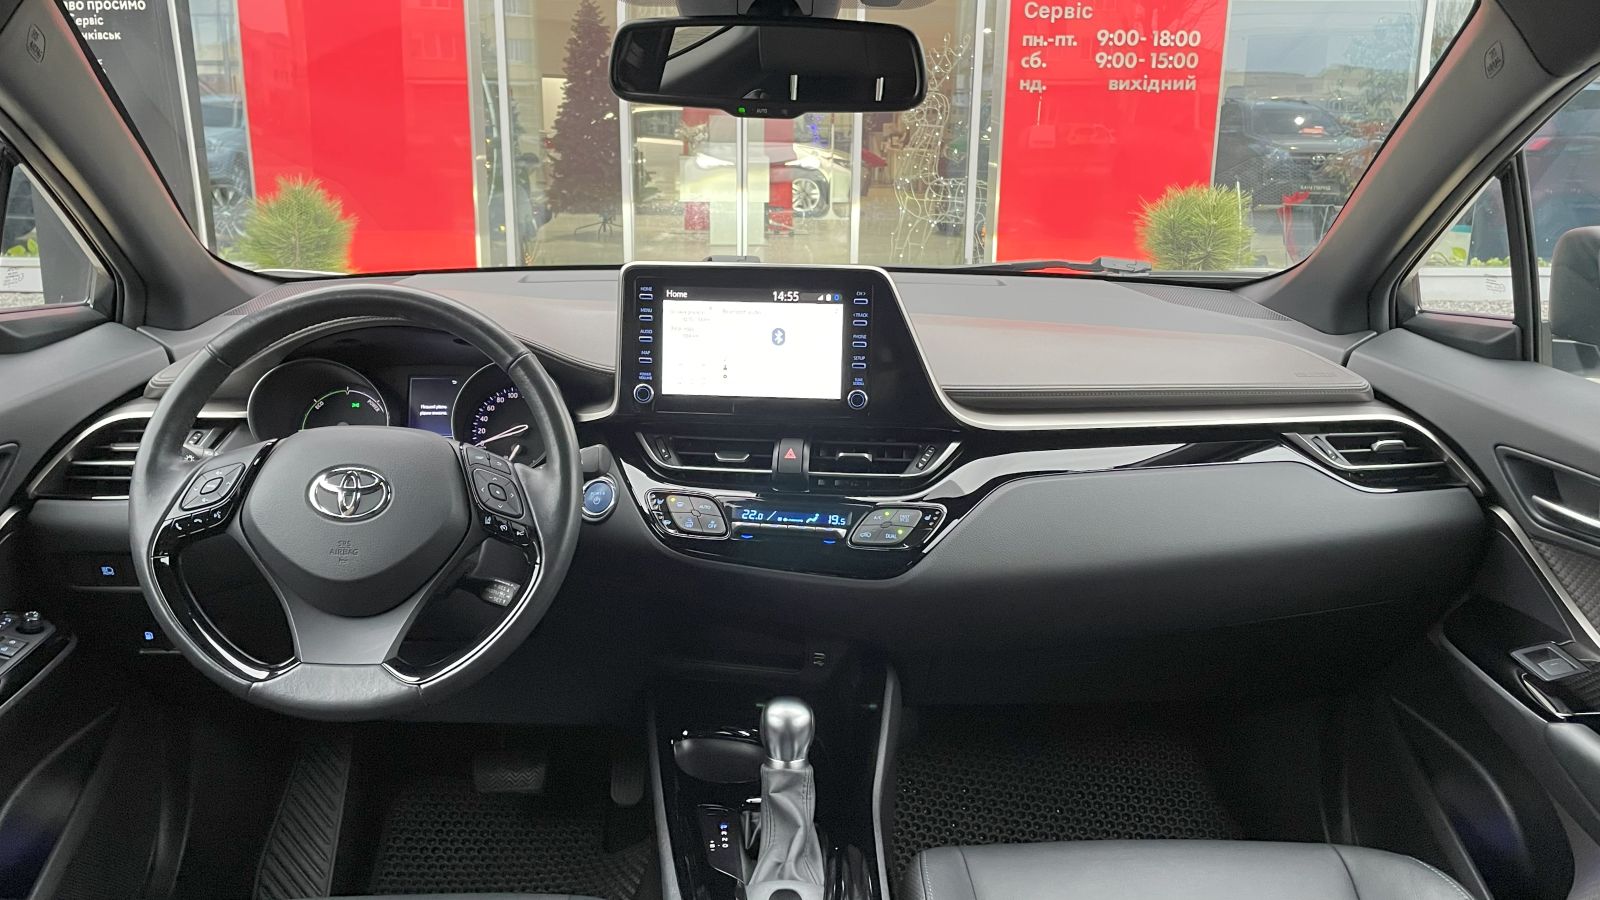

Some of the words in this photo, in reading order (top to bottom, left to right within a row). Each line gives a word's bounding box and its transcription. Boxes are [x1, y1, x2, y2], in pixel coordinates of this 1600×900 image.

[87, 0, 146, 14] просимо
[1024, 1, 1093, 23] Сервіс
[70, 13, 104, 28] ервіс
[1022, 34, 1077, 47] пн.-пт.
[1152, 30, 1201, 47] 18:00
[1021, 51, 1047, 68] сб.
[1150, 53, 1199, 69] 15:00
[1019, 78, 1047, 92] нд.
[1109, 75, 1196, 92] вихідний
[666, 289, 688, 298] Home
[772, 291, 799, 302] 14:55
[741, 509, 764, 520] 22.0
[828, 515, 846, 526] 19.5
